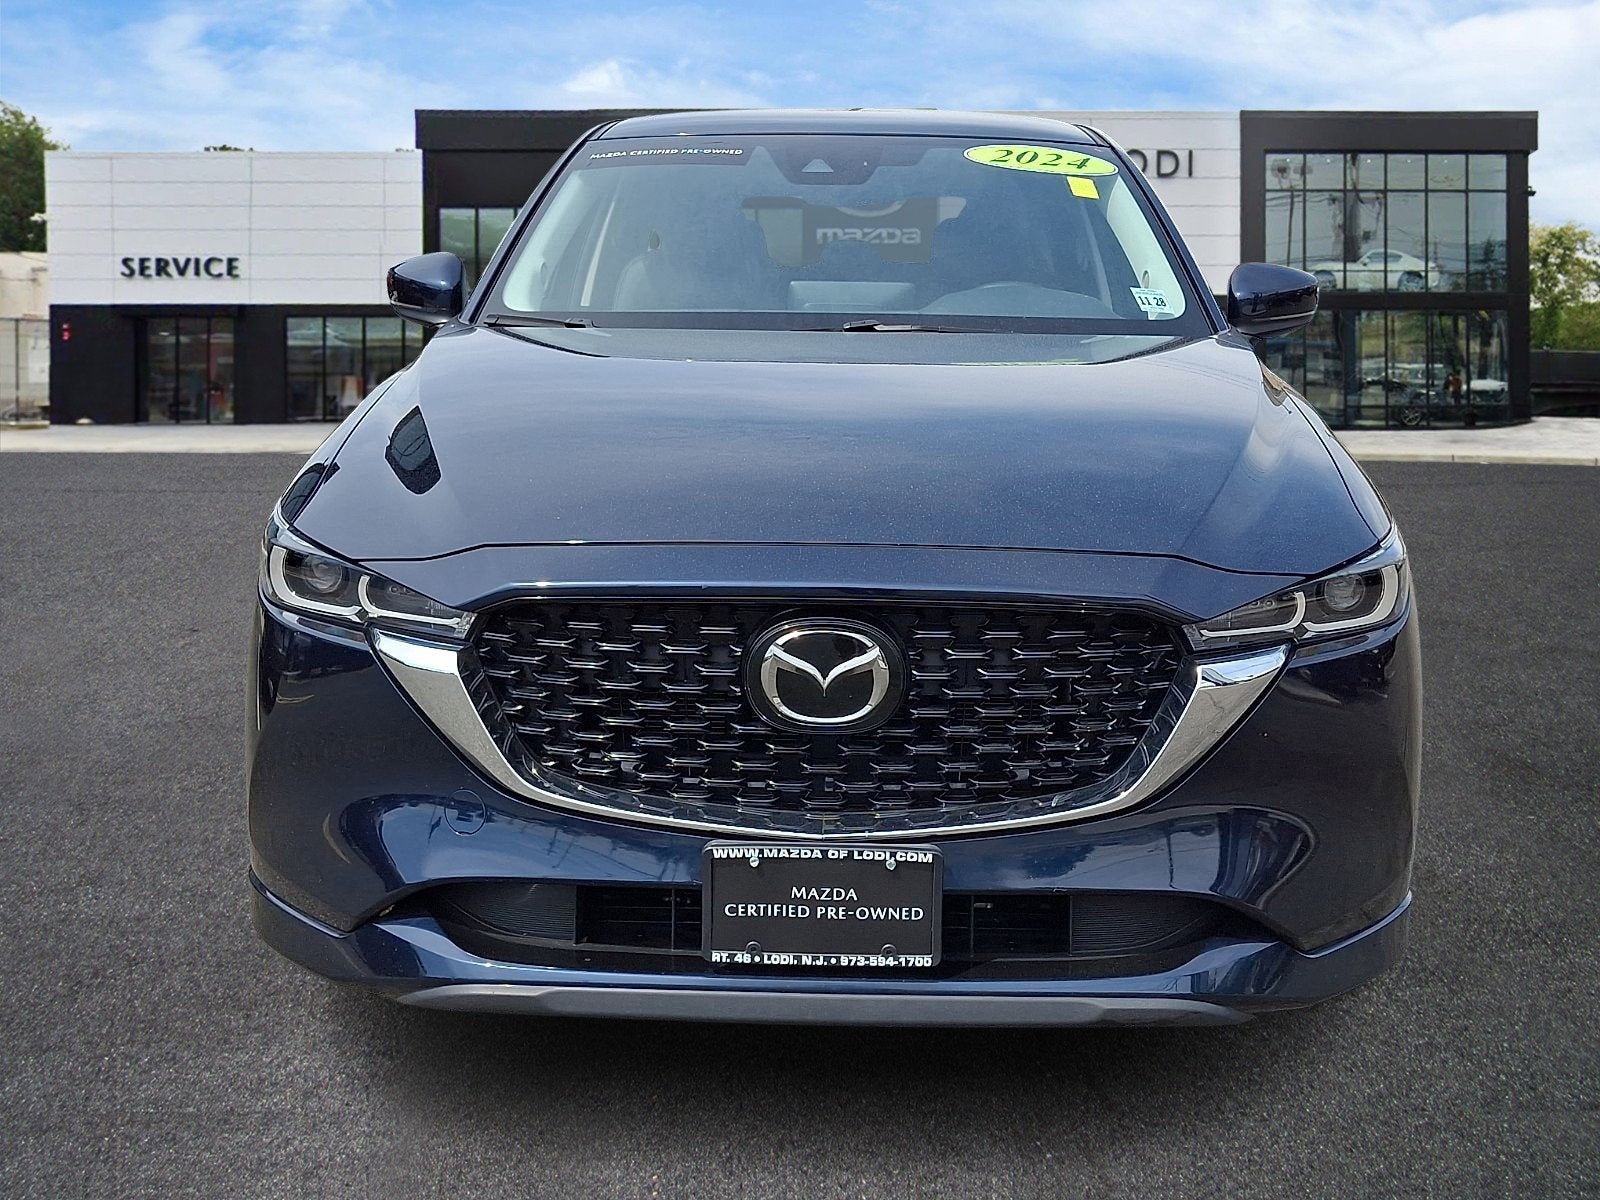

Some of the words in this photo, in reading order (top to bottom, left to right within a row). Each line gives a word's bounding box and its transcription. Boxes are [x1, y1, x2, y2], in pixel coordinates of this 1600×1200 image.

[590, 151, 627, 159] MAZDA
[990, 149, 1090, 169] 2024
[120, 257, 240, 278] SERVICE
[1138, 296, 1152, 305] 11
[828, 849, 848, 859] OF
[791, 886, 858, 901] MAZDA
[724, 903, 810, 918] CERTIFIED
[816, 906, 924, 921] PRE-OWNED
